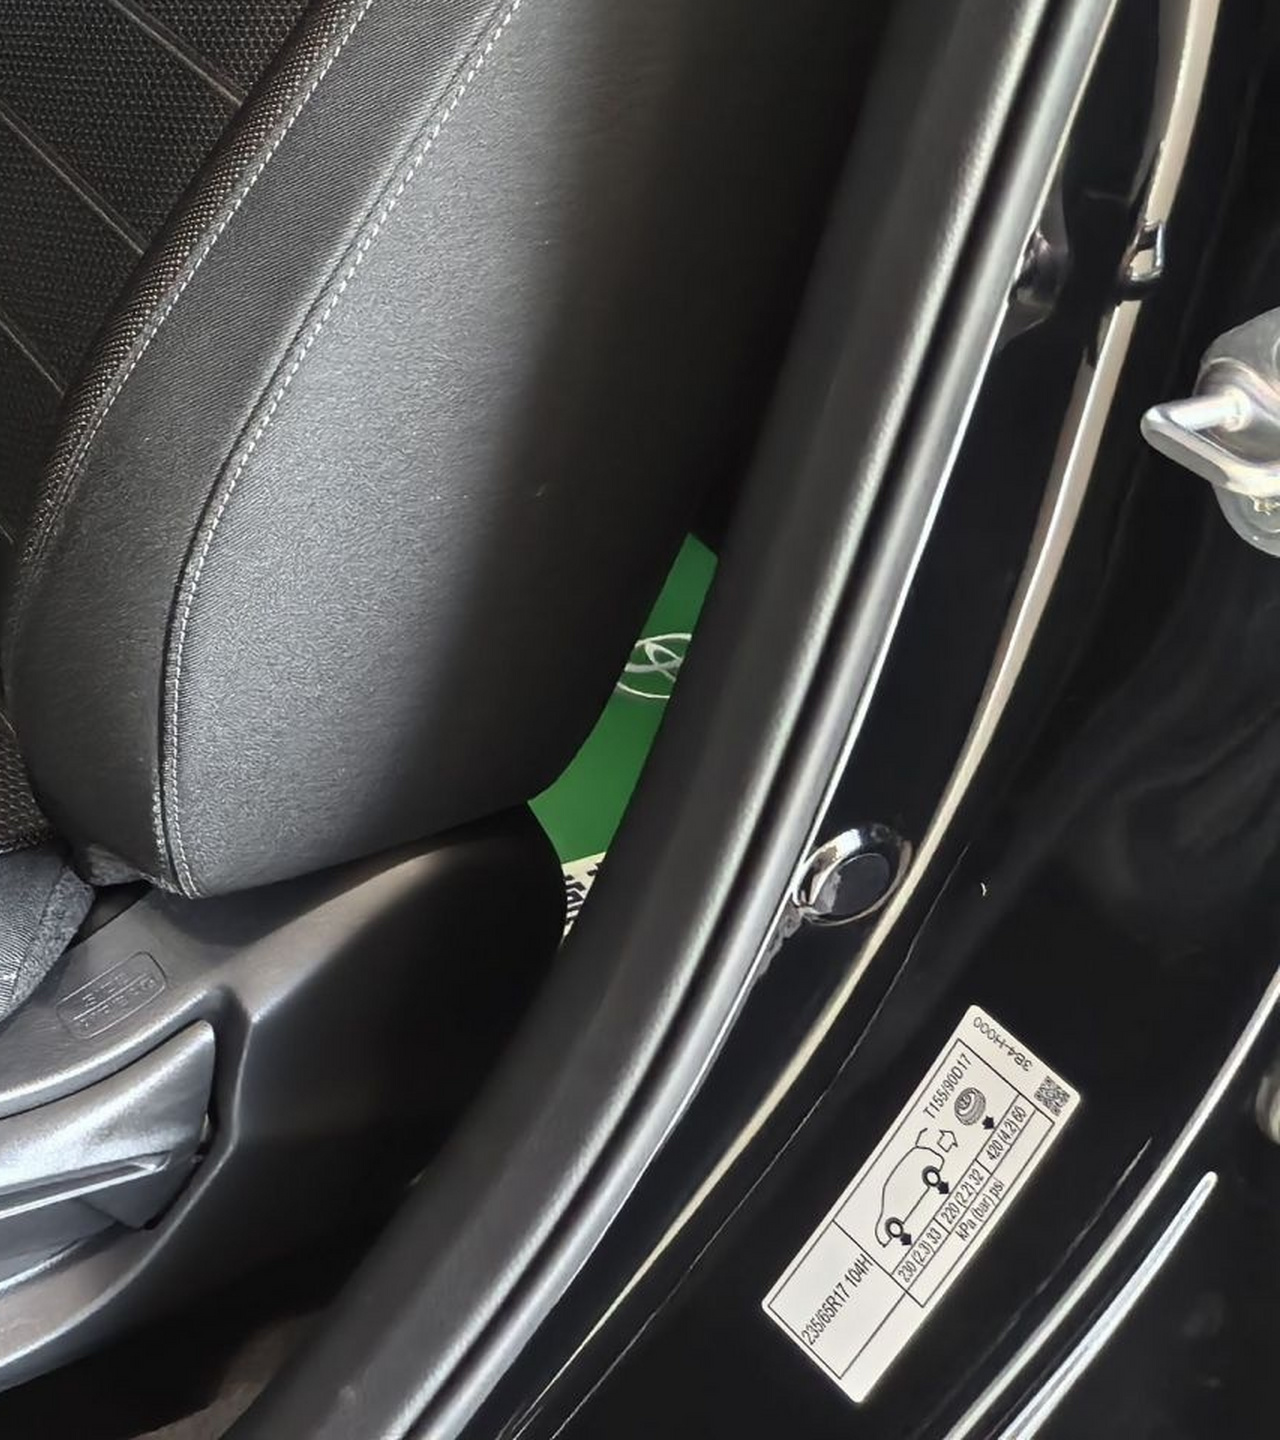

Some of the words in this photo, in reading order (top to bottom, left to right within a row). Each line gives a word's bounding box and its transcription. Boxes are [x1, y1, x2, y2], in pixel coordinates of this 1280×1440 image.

[924, 1052, 971, 1119] T155/90D17
[987, 1139, 1005, 1162] 420
[999, 1117, 1020, 1149] (4.2)
[1013, 1105, 1027, 1124] 60
[940, 1202, 959, 1225] 220
[955, 1178, 977, 1209] (2.2)
[970, 1168, 984, 1186] 32
[956, 1218, 976, 1242] kPa
[971, 1194, 994, 1224] (bar)
[991, 1179, 1005, 1202] psi
[898, 1261, 916, 1284] 230
[913, 1239, 934, 1271] (2.3)
[927, 1228, 942, 1246] 33
[801, 1284, 850, 1346] 235/65R17
[847, 1253, 874, 1288] 104H
